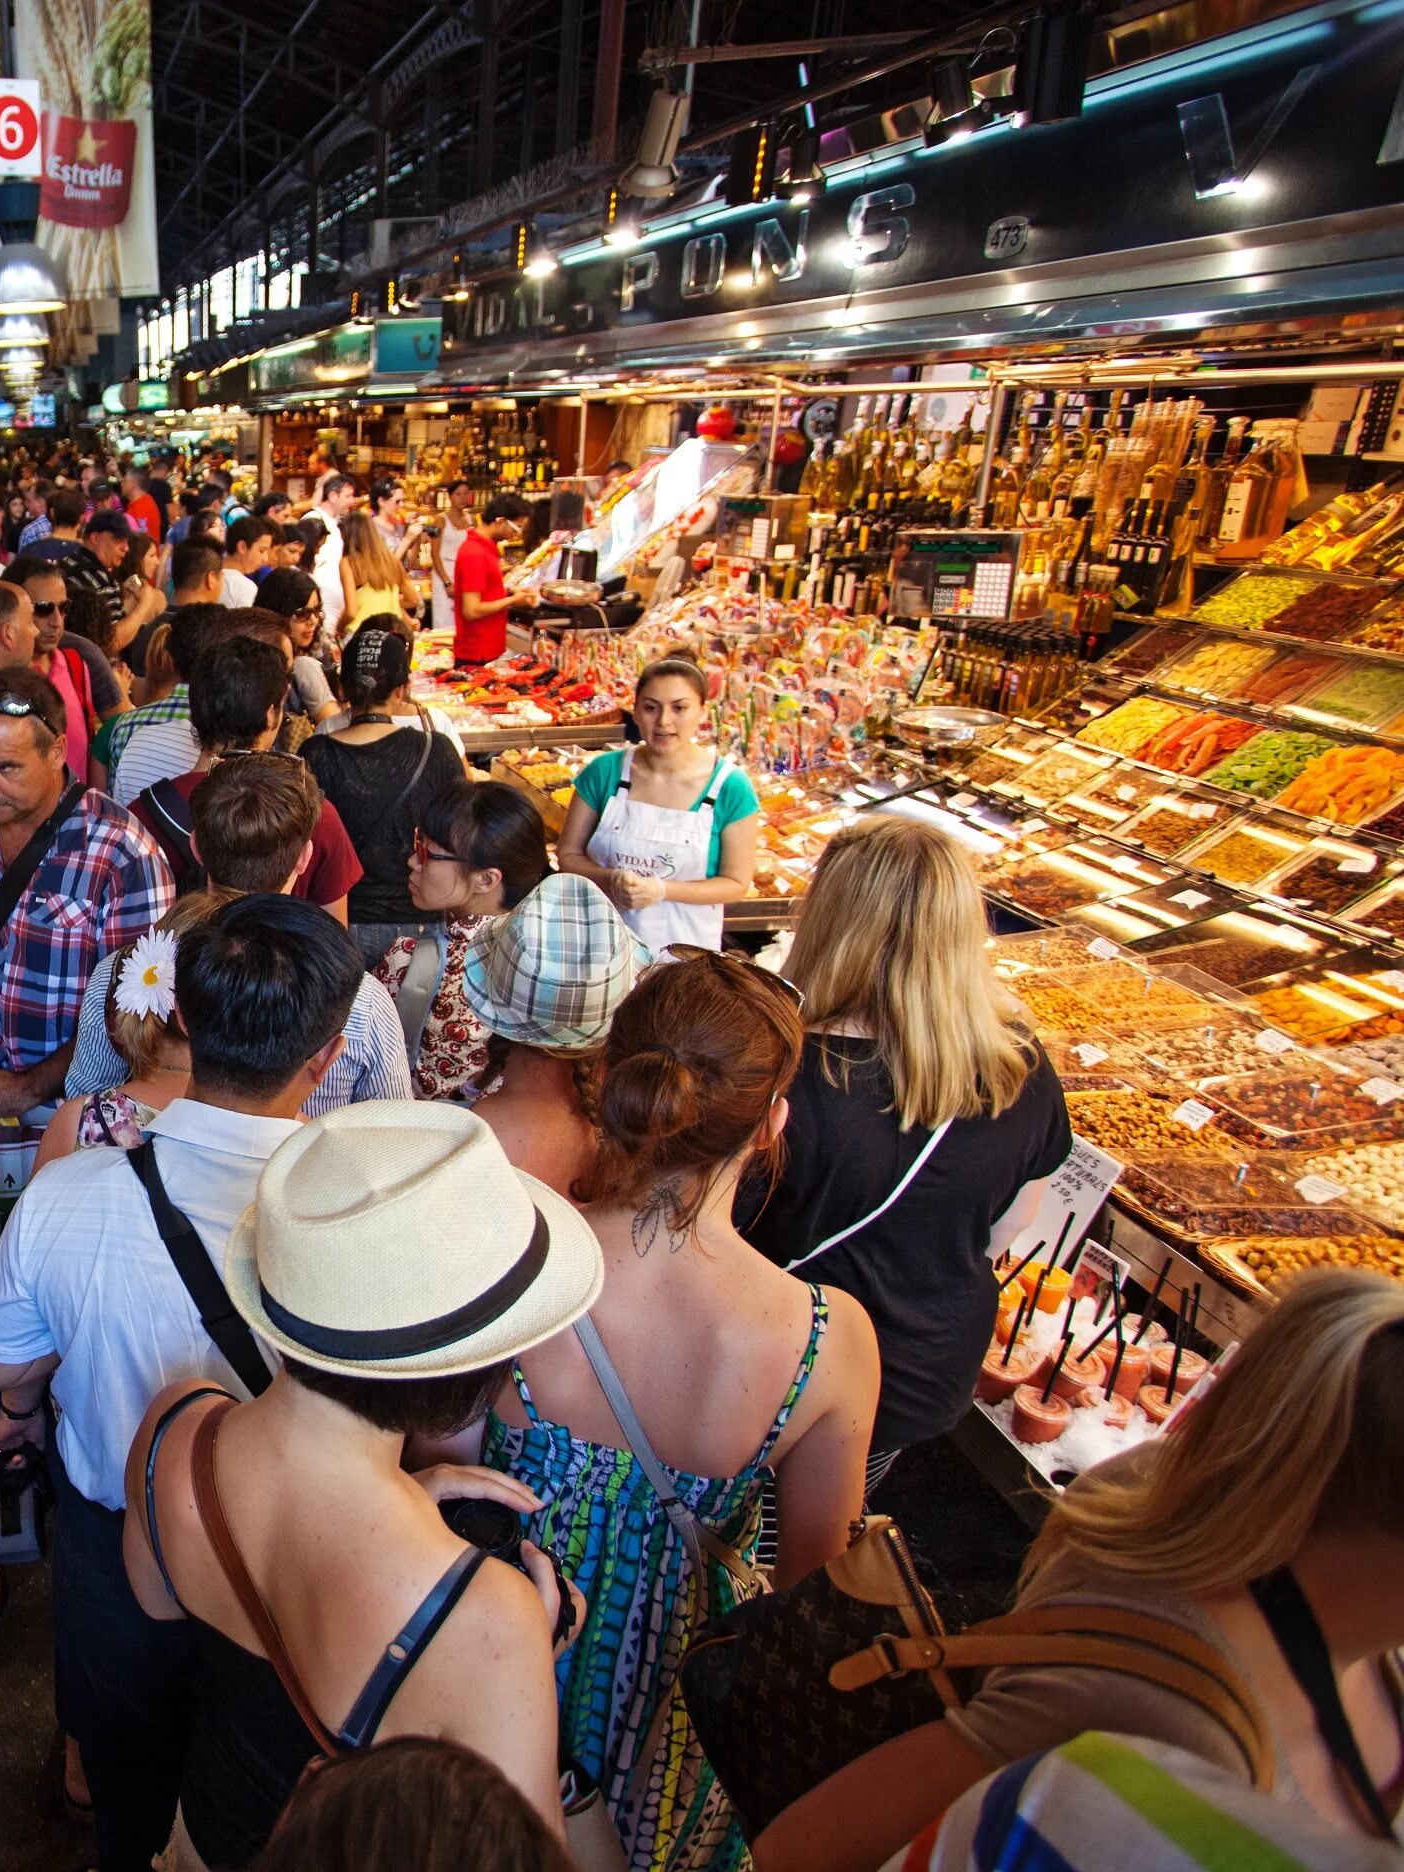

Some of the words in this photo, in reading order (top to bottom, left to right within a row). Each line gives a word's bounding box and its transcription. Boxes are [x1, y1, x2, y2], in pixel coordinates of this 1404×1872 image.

[46, 153, 123, 188] Estrella
[620, 182, 916, 313] PONS
[990, 225, 1021, 249] 473
[615, 853, 659, 869] VIDAL
[1058, 1172, 1083, 1190] 100%
[1065, 1158, 1107, 1191] ATURALS
